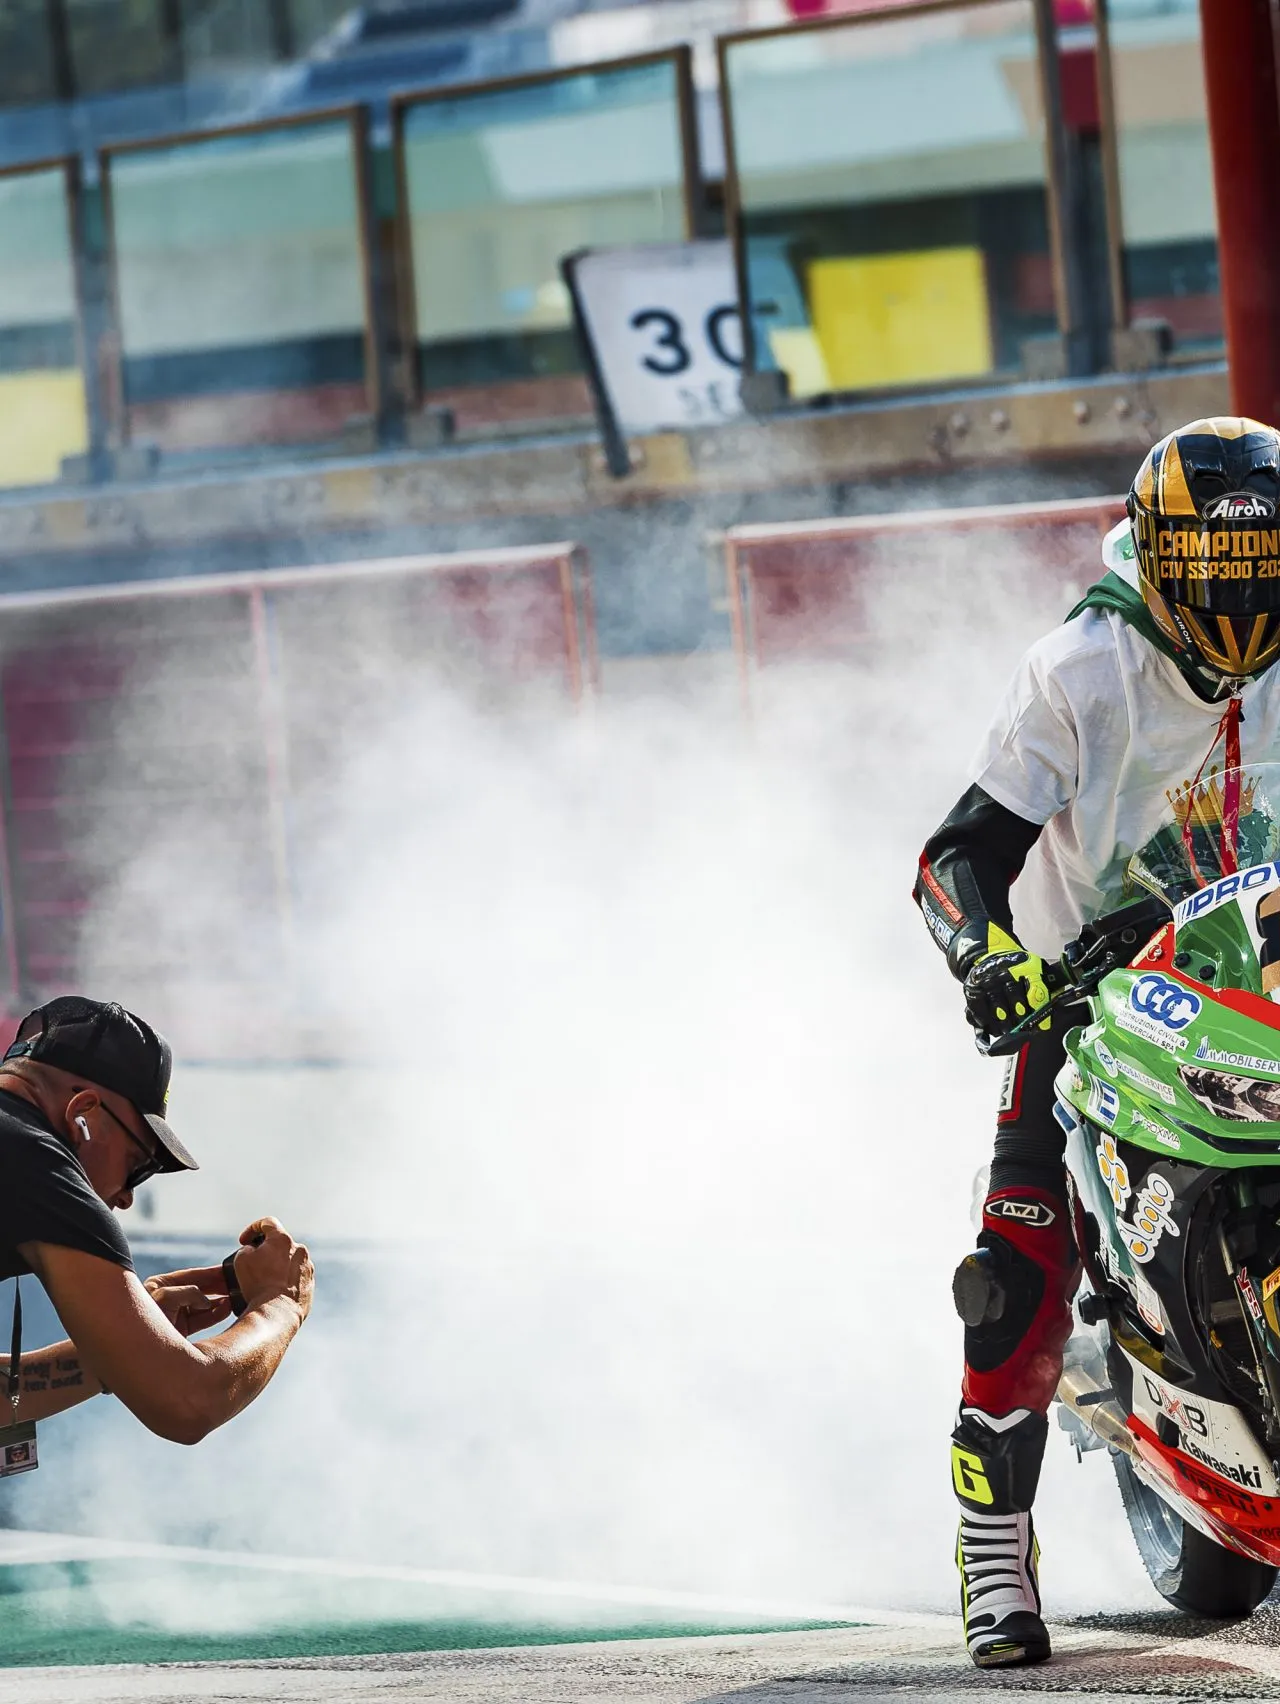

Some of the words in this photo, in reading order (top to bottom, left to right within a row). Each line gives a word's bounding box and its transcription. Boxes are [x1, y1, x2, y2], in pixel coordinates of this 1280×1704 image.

[1210, 498, 1268, 519] Airoh
[1160, 562, 1183, 580] CIV
[1188, 560, 1253, 580] SSP300
[1174, 614, 1192, 643] AIROH
[1161, 1040, 1175, 1052] SPA
[1178, 1431, 1263, 1489] Kawasaki
